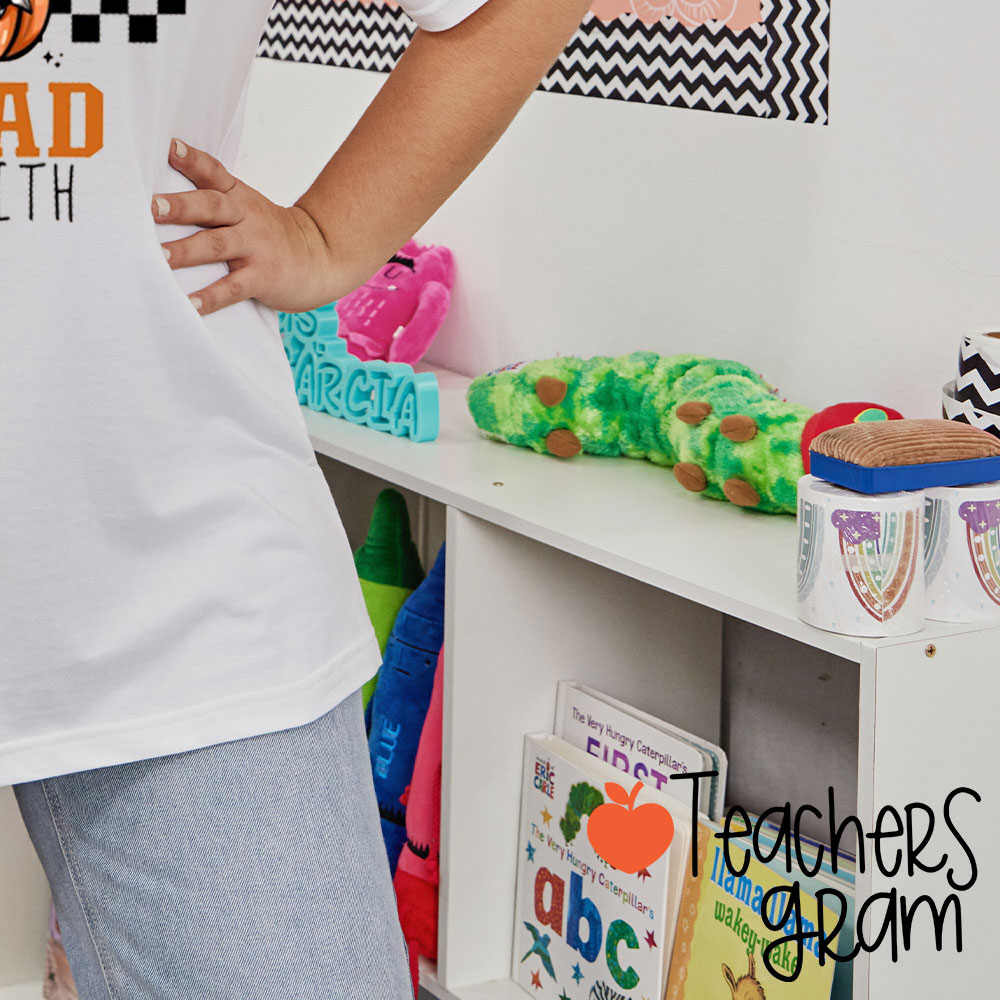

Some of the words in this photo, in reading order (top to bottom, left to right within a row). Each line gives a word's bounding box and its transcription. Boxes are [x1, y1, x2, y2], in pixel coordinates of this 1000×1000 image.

[288, 347, 417, 436] ARCIA
[374, 718, 401, 779] BLUE
[535, 761, 555, 786] ERIC
[572, 706, 586, 724] The
[587, 714, 604, 735] Very
[605, 726, 635, 751] Hungry
[636, 739, 688, 774] Caterpillar's
[534, 775, 555, 800] CARLE
[531, 822, 545, 842] The
[547, 834, 565, 860] Very
[566, 850, 596, 883] Hungry
[598, 872, 654, 920] Caterpillar's
[710, 846, 764, 916] llama
[534, 866, 641, 990] abc
